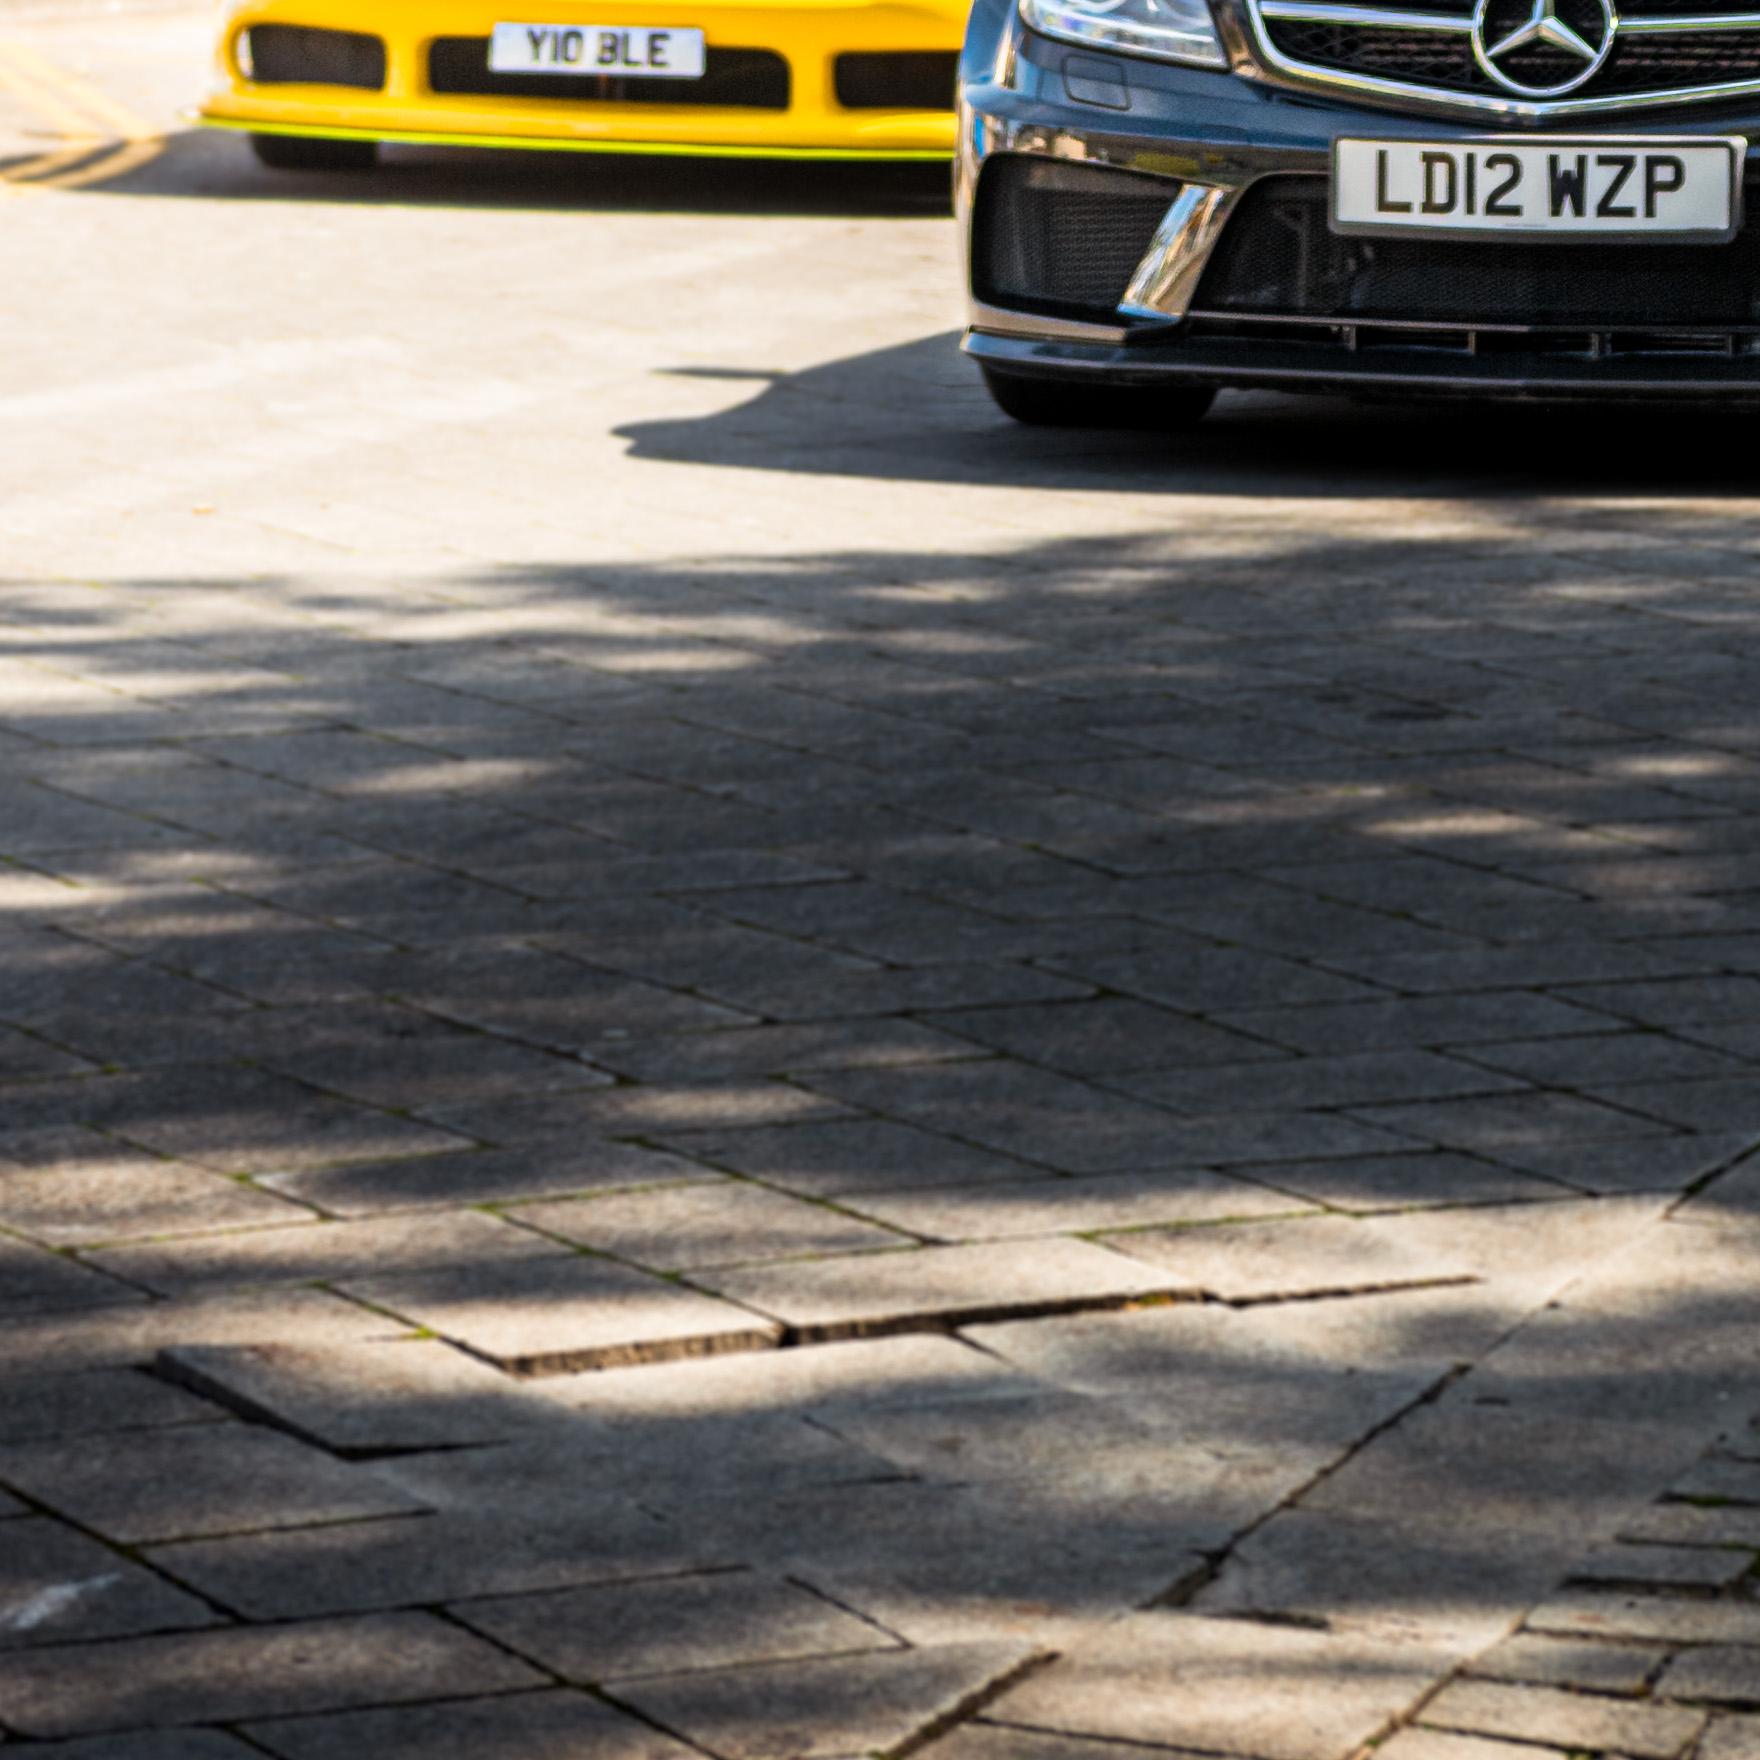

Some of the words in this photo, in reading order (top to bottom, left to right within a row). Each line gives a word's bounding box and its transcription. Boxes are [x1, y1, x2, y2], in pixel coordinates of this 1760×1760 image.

[526, 28, 584, 65] Y10
[1376, 149, 1523, 216] LD12
[1549, 153, 1686, 218] WZP
